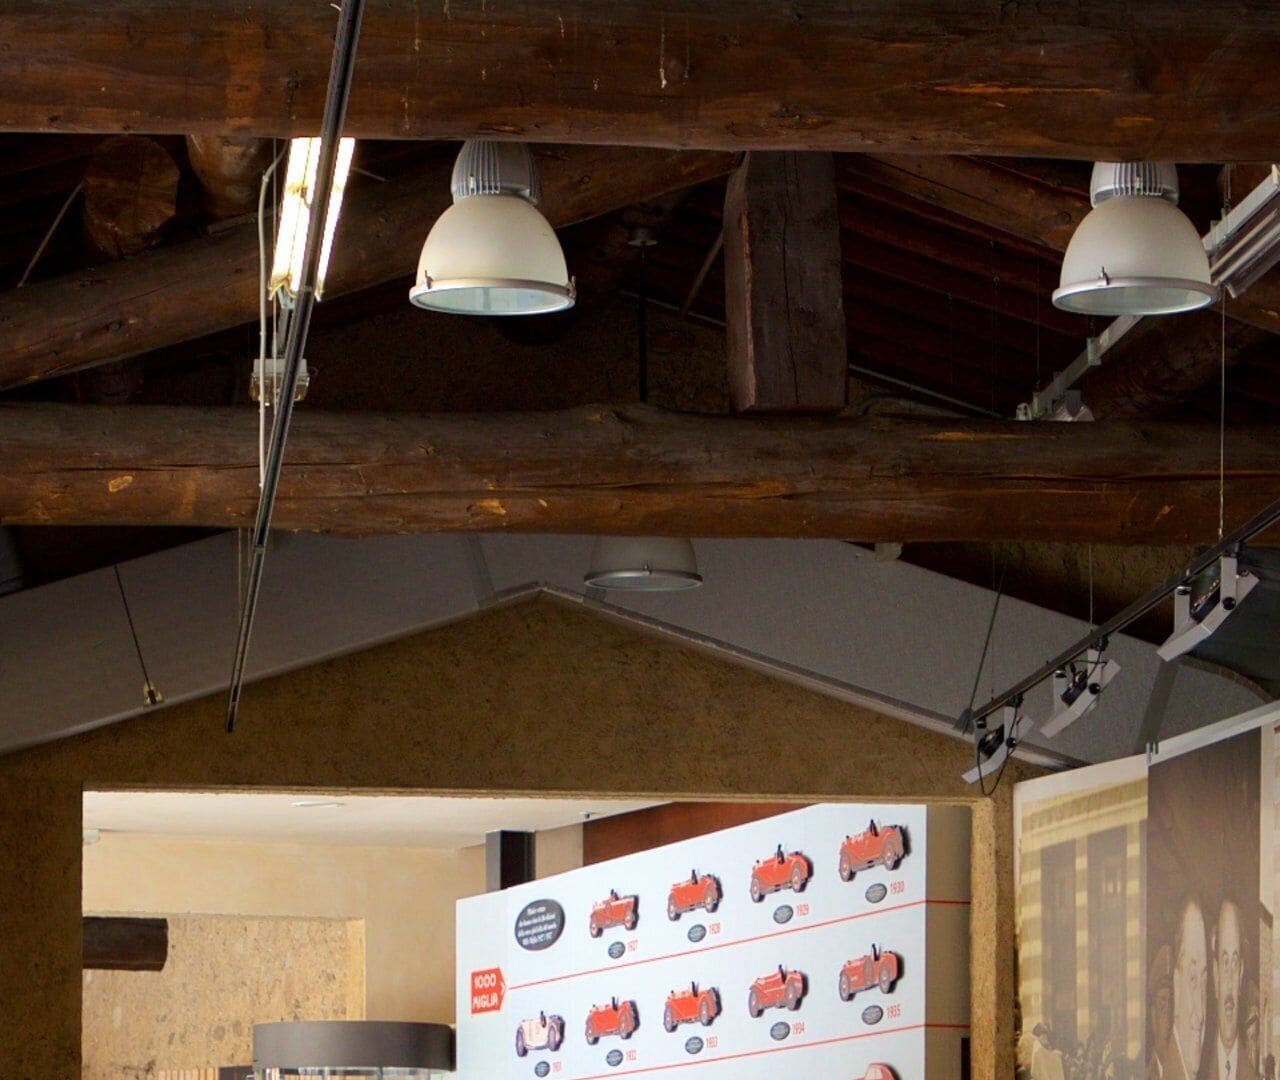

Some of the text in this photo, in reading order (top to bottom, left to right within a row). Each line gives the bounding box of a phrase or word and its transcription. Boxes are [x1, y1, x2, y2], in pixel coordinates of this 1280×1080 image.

[889, 880, 905, 895] 1930
[473, 974, 497, 990] 1000
[472, 992, 498, 1009] MIGLIA
[886, 1004, 901, 1019] 1935
